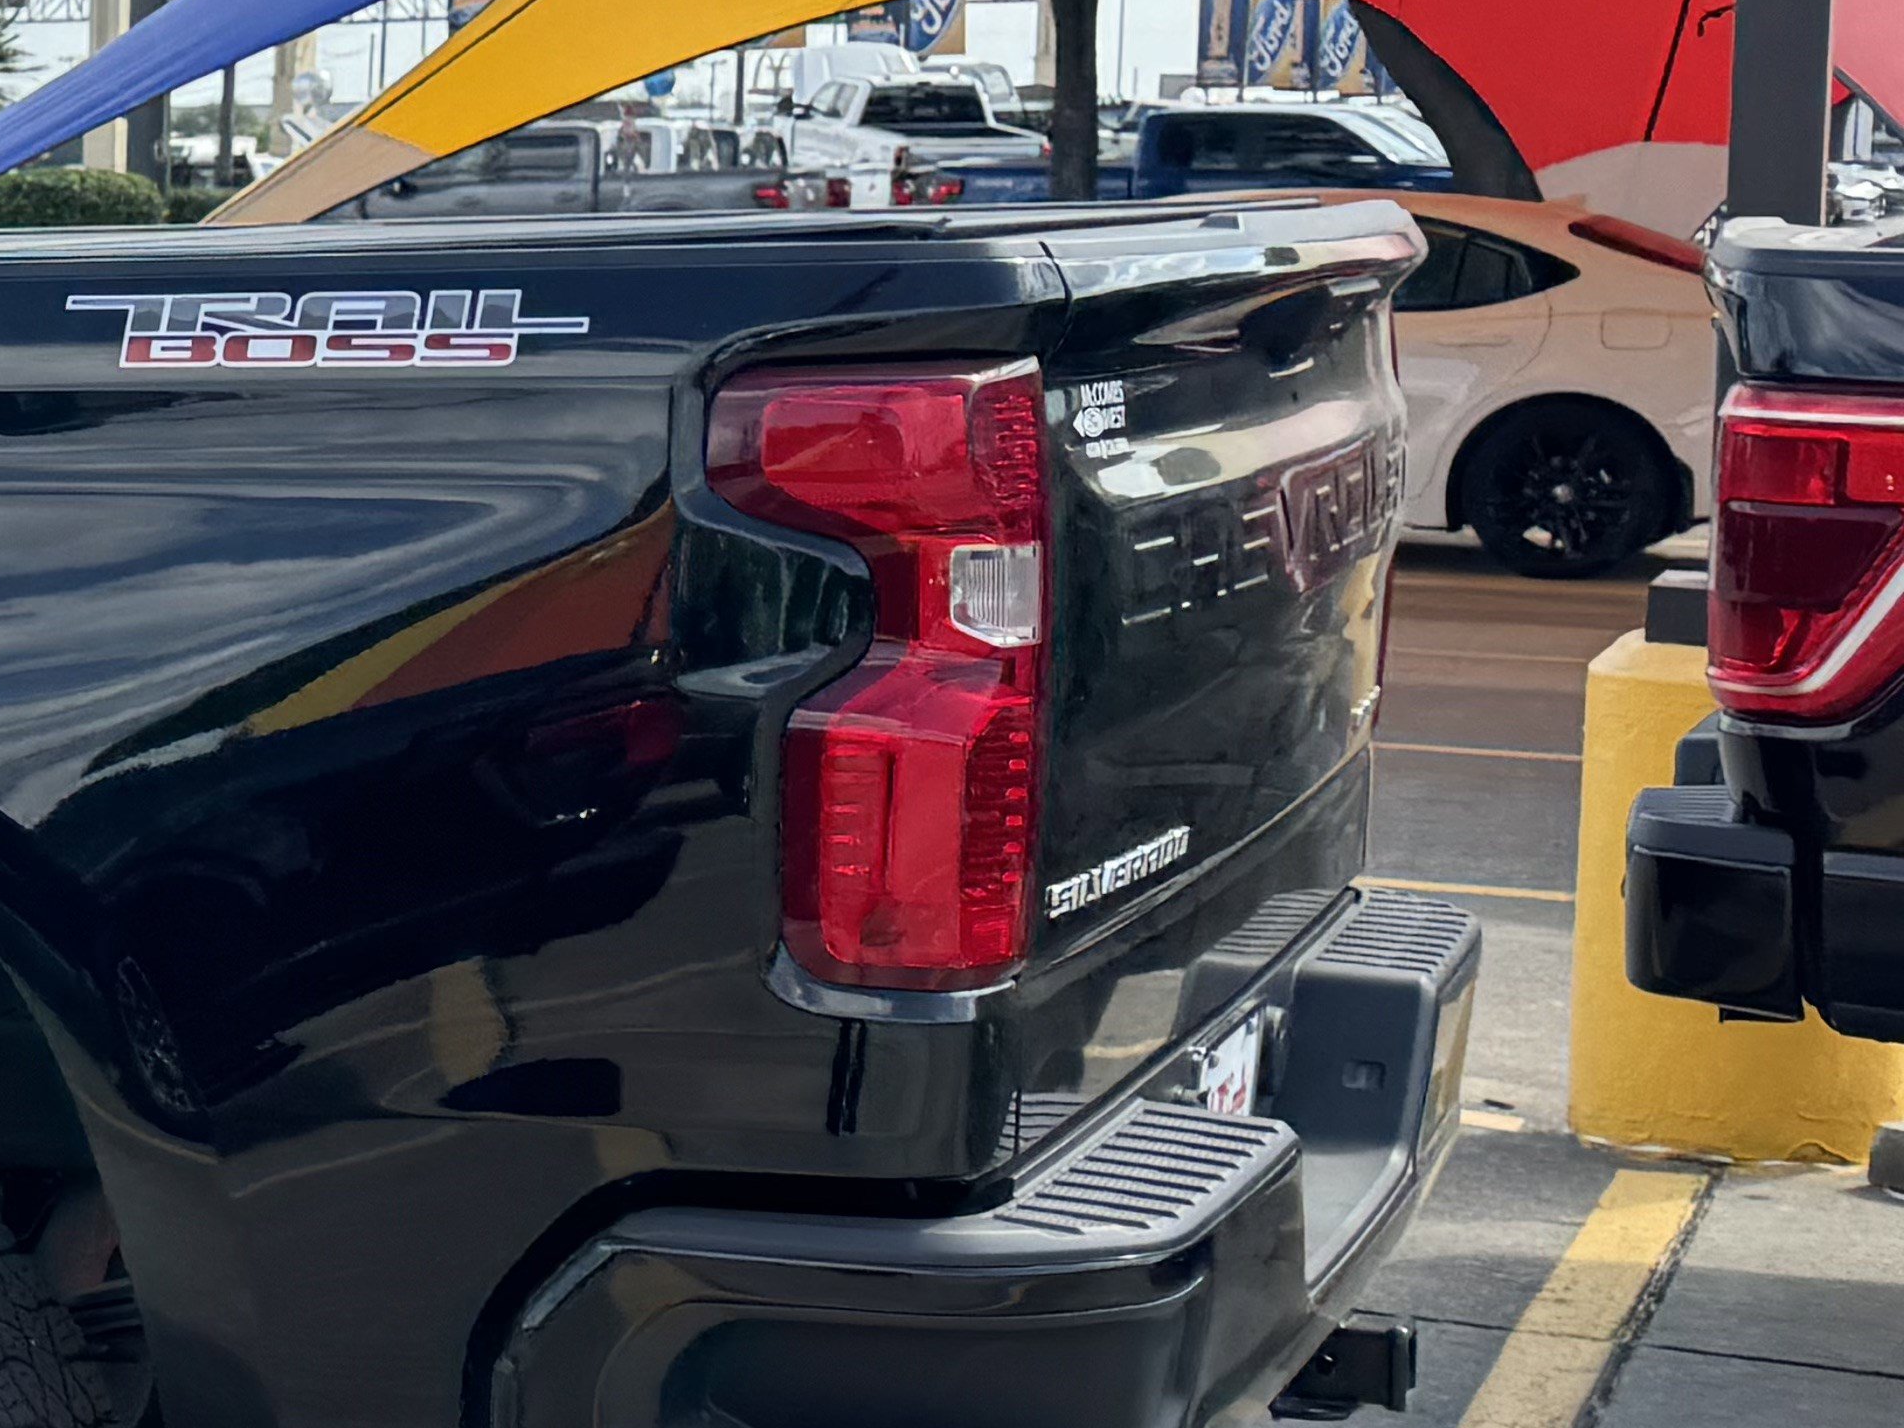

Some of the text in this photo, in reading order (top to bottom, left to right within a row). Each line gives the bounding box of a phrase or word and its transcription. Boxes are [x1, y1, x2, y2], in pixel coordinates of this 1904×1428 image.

[1247, 0, 1291, 72] Ford
[1319, 10, 1360, 78] Ford
[65, 289, 590, 334] TRAIL
[118, 330, 520, 368] BOSS
[1044, 825, 1191, 919] SILVERADO
